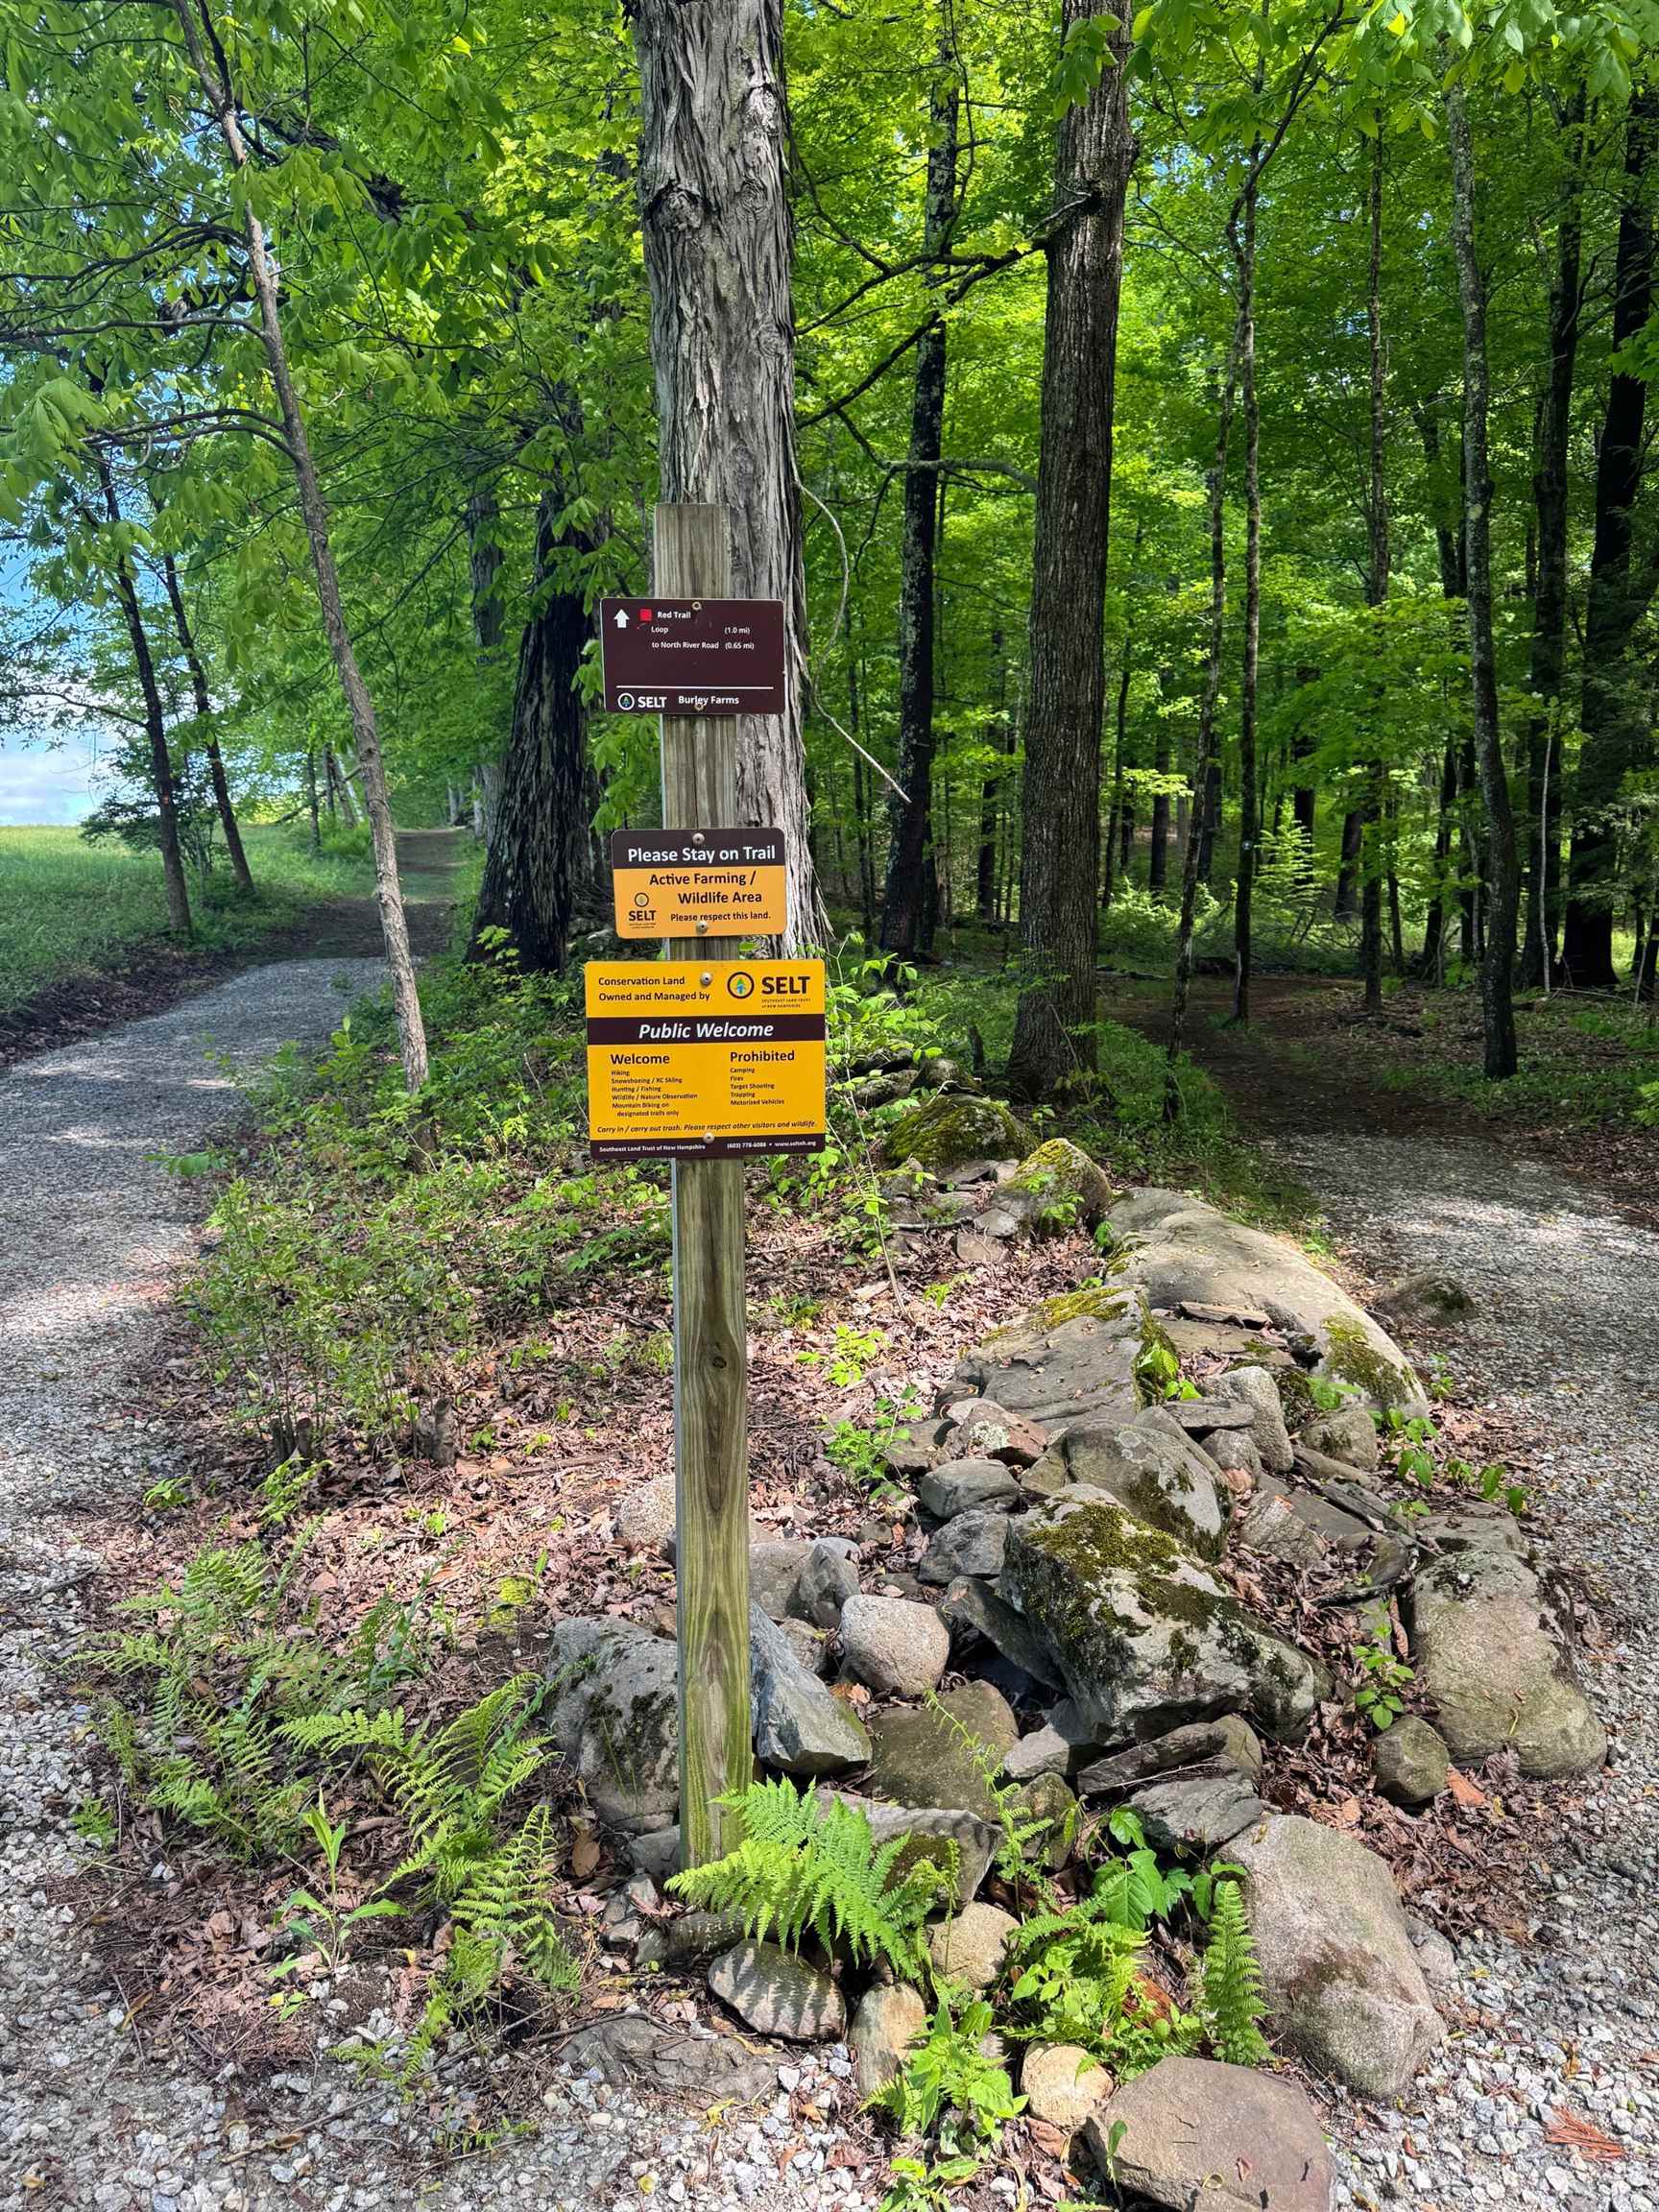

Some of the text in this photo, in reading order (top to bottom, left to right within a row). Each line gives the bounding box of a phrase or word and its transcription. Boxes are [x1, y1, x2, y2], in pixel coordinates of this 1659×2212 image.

[657, 611, 691, 619] Red Trail
[651, 626, 751, 636] Loop (1.0 mi)
[725, 641, 742, 651] (0.65
[742, 641, 755, 651] mi)
[637, 696, 667, 709] SELT
[678, 695, 739, 707] Burley Farms
[628, 846, 776, 864] Please Stay on Trail
[649, 871, 757, 886] Active Farming /
[678, 891, 762, 904] Wildlife Area
[629, 910, 657, 921] SELT
[670, 910, 771, 924] Please respect this land.
[598, 975, 685, 986] Conservation Land
[761, 976, 810, 995] SELT
[598, 991, 710, 1002] Owned and Managed by
[638, 1022, 774, 1039] Public Welcome
[610, 1053, 670, 1065] Welcome
[730, 1050, 795, 1062] Prohibited
